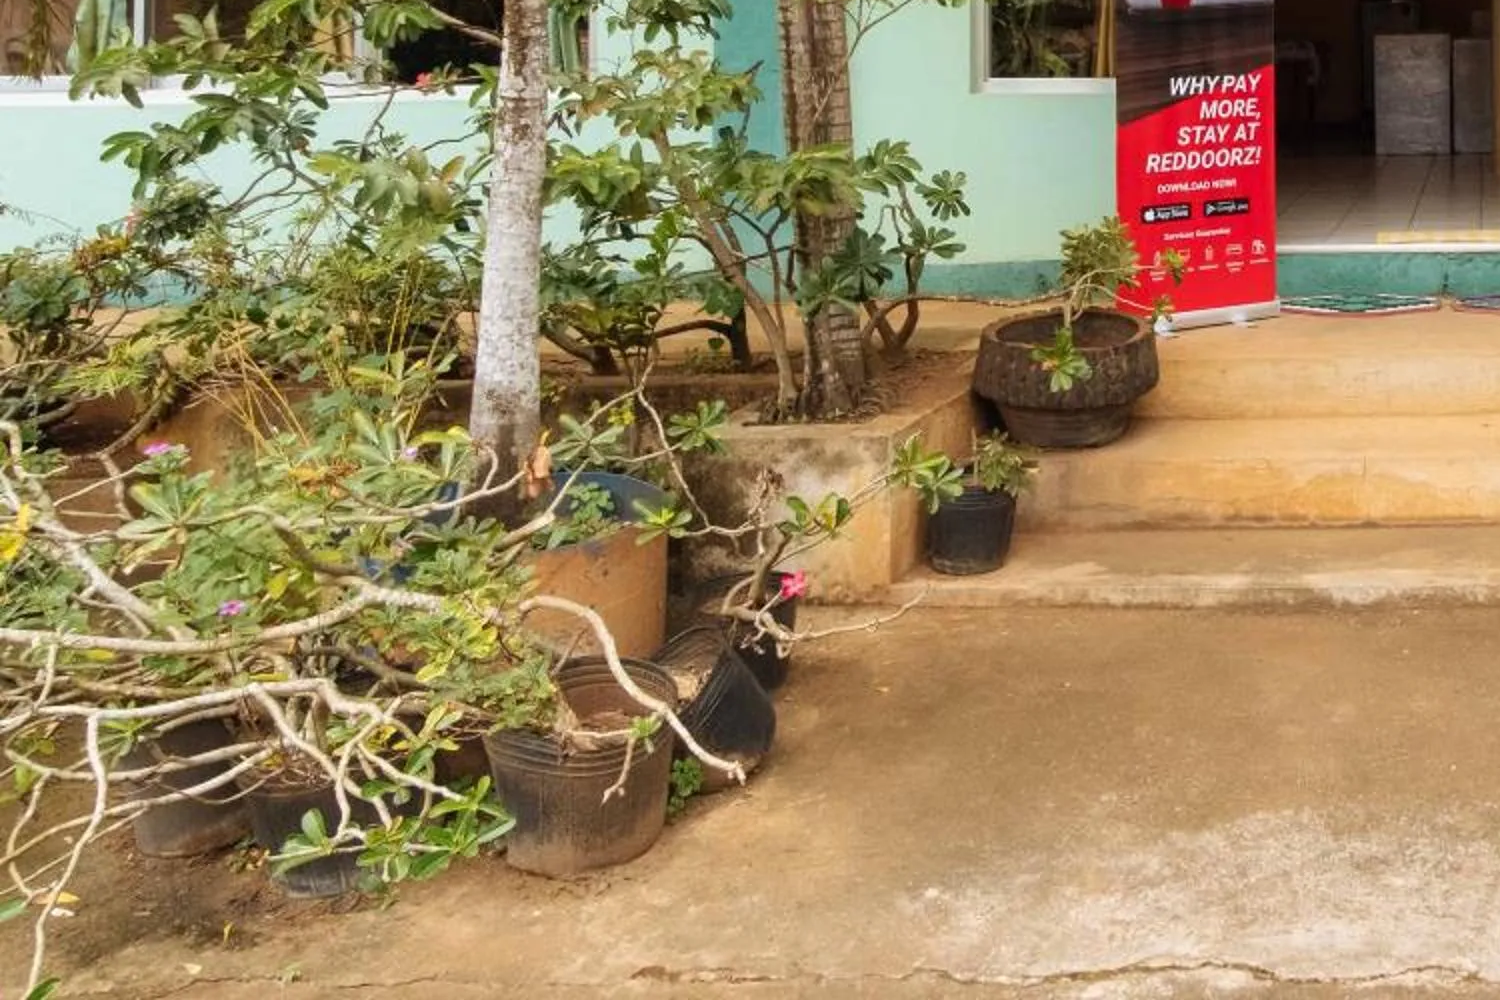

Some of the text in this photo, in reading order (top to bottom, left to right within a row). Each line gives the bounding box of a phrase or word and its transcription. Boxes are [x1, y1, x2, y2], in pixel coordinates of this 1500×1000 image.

[1170, 73, 1262, 96] WHY PAY
[1199, 98, 1261, 120] MORE,
[1177, 122, 1261, 146] STAY AT
[1145, 146, 1262, 174] REDDOORZ!
[1157, 180, 1210, 194] DOWNLOAD
